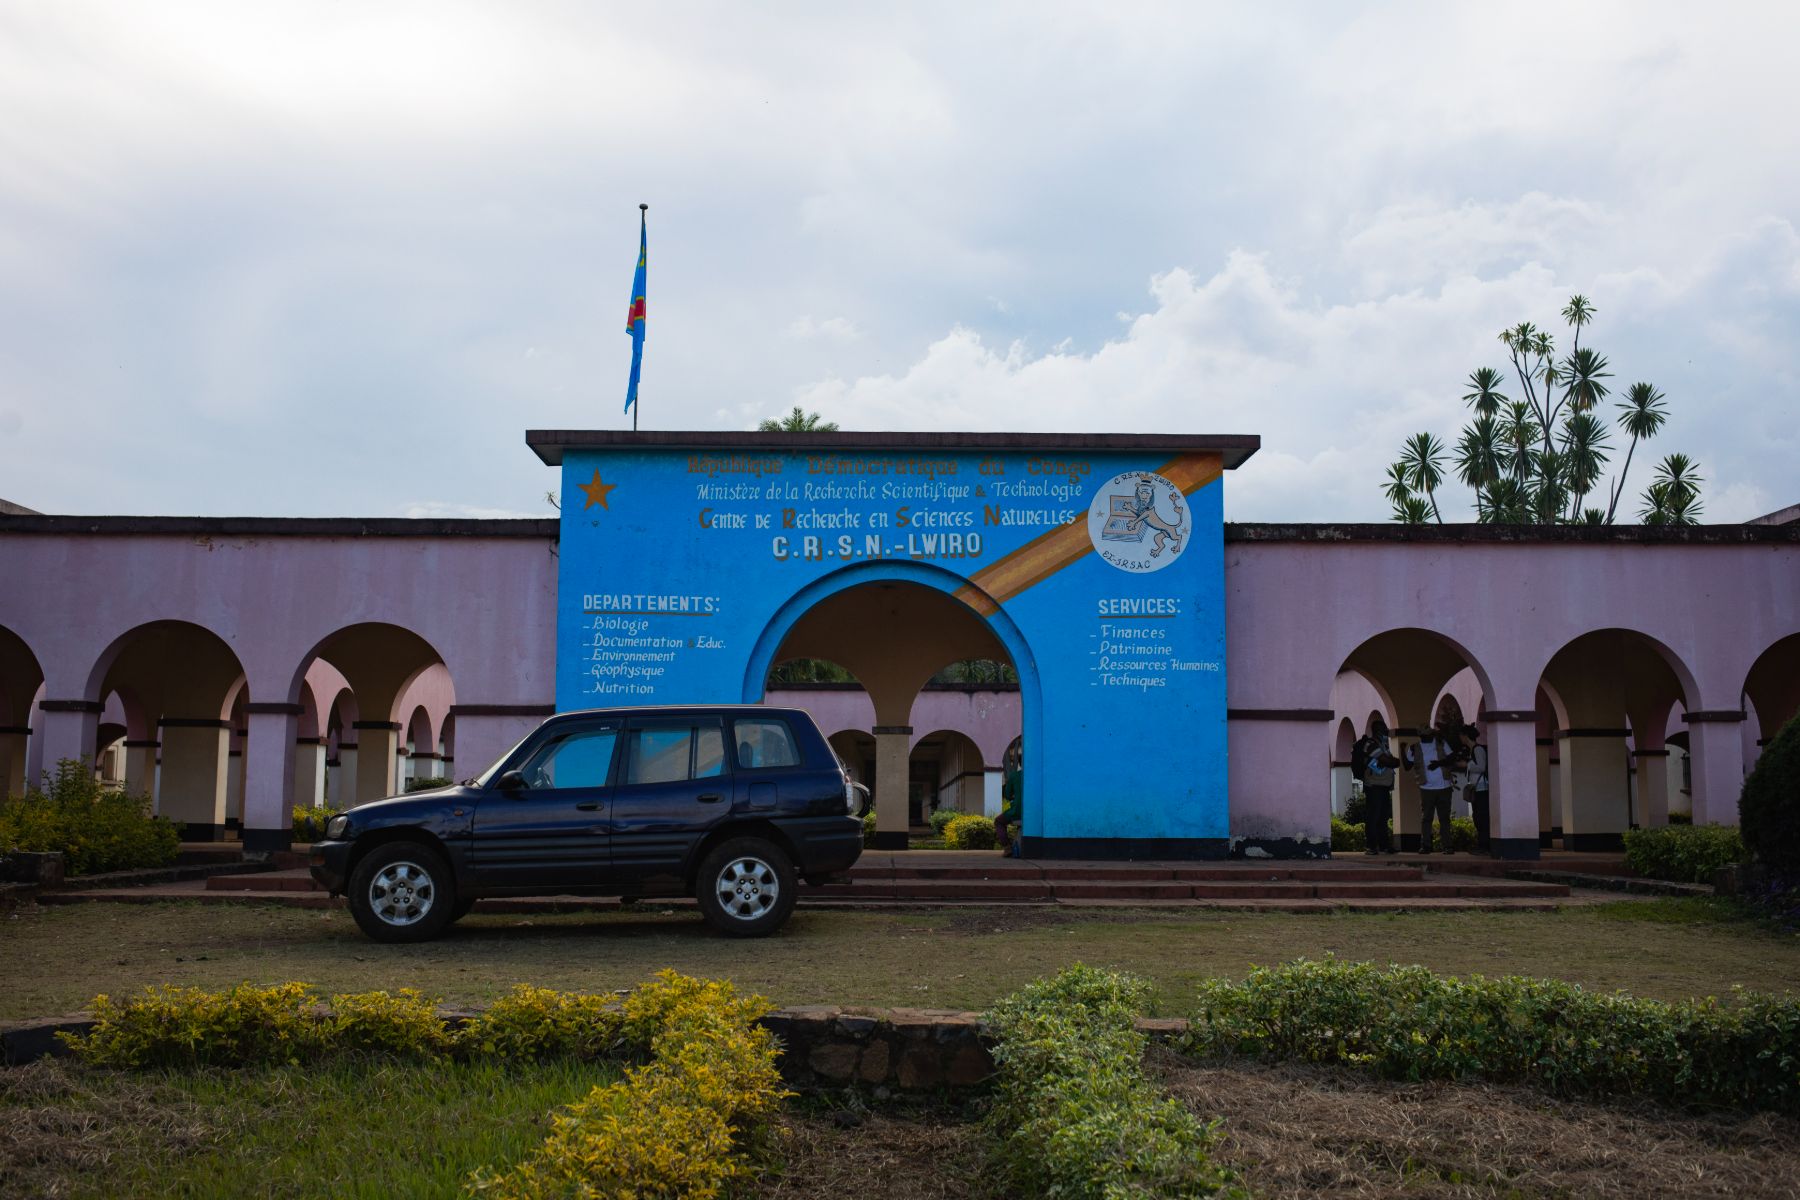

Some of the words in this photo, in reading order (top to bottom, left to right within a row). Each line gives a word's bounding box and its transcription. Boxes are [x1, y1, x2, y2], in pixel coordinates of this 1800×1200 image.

[807, 455, 958, 480] Démocratique
[979, 455, 1004, 475] du
[1028, 456, 1091, 484] Congo
[697, 482, 760, 500] Ministère
[766, 481, 782, 500] de
[785, 481, 798, 500] la
[805, 480, 876, 501] Recherche
[882, 482, 970, 503] Scientifique
[991, 480, 1082, 502] Technologie
[583, 594, 720, 612] DEPARTEMENTS:
[1098, 598, 1181, 614] SERVICES:
